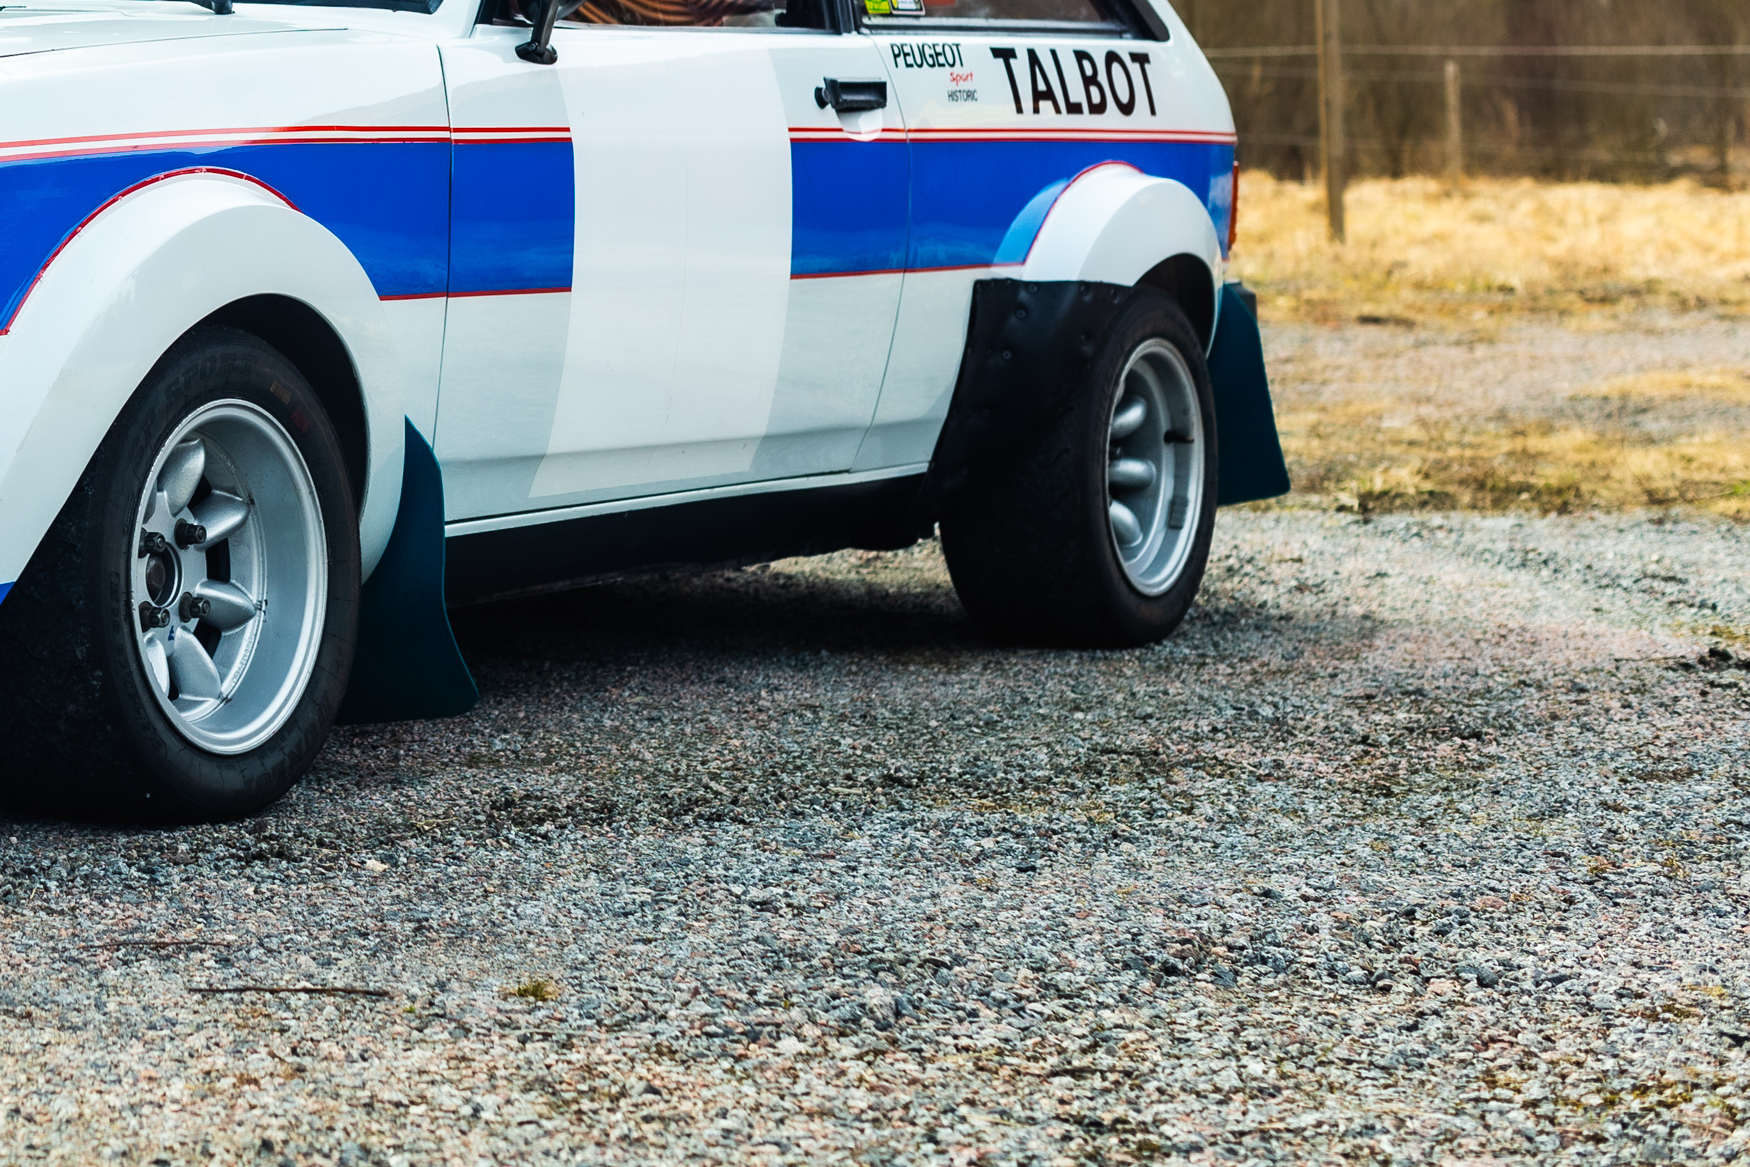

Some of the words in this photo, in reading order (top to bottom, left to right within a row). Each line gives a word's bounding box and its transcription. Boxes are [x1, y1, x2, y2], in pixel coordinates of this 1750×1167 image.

[891, 43, 964, 69] PEUGEOT
[949, 71, 974, 87] Sport
[990, 47, 1157, 117] TALBOT
[947, 89, 978, 102] HISTORIC
